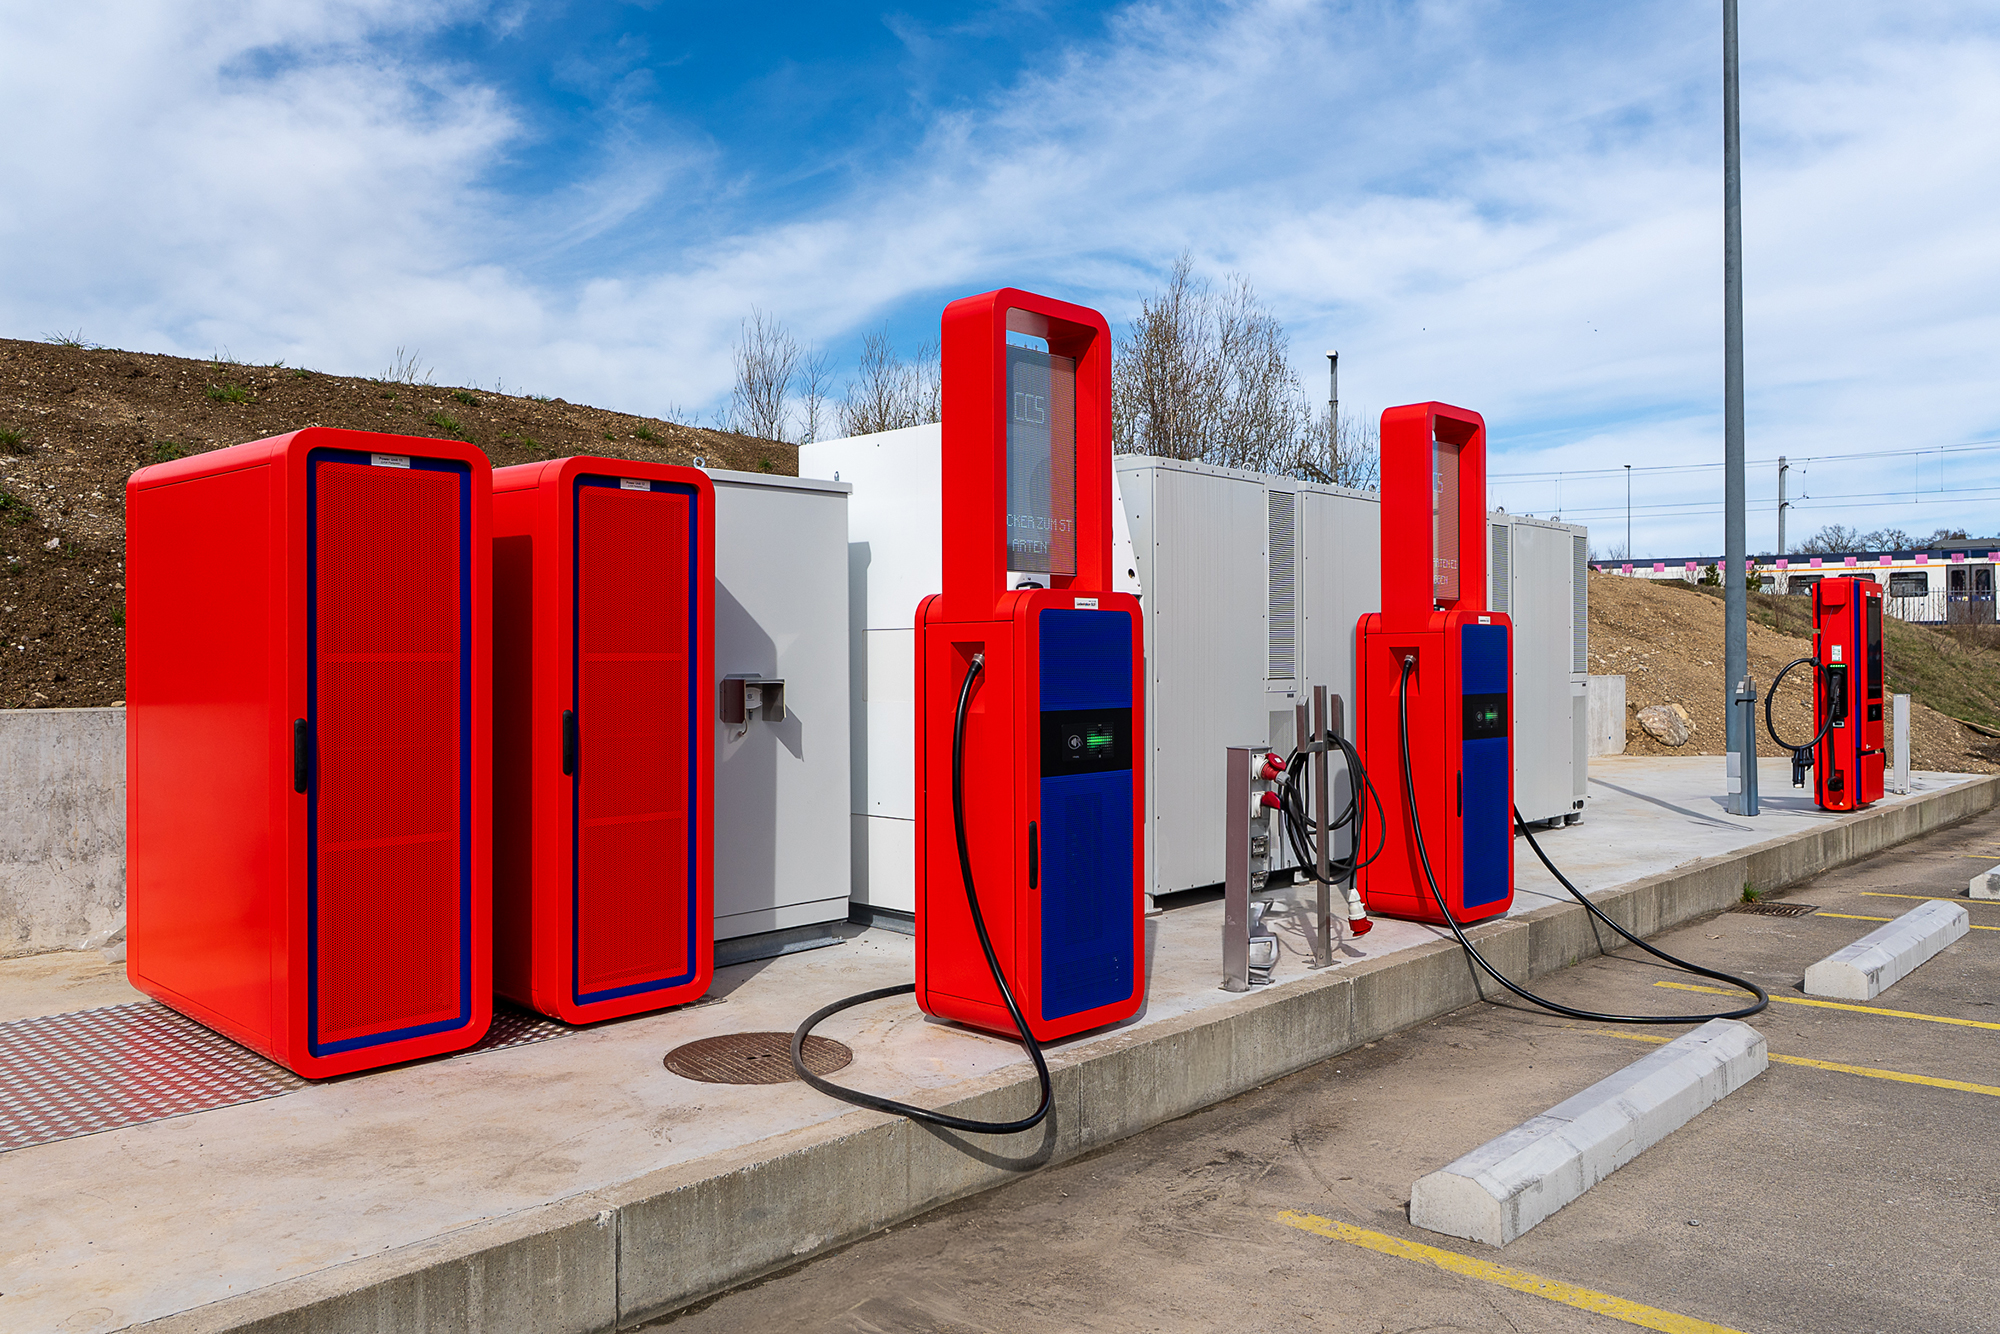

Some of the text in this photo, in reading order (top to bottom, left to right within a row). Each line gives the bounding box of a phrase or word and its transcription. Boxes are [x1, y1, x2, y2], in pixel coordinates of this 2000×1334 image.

[1036, 516, 1057, 531] ZUM
[1059, 519, 1072, 532] ST
[1012, 538, 1048, 554] ARTEN
